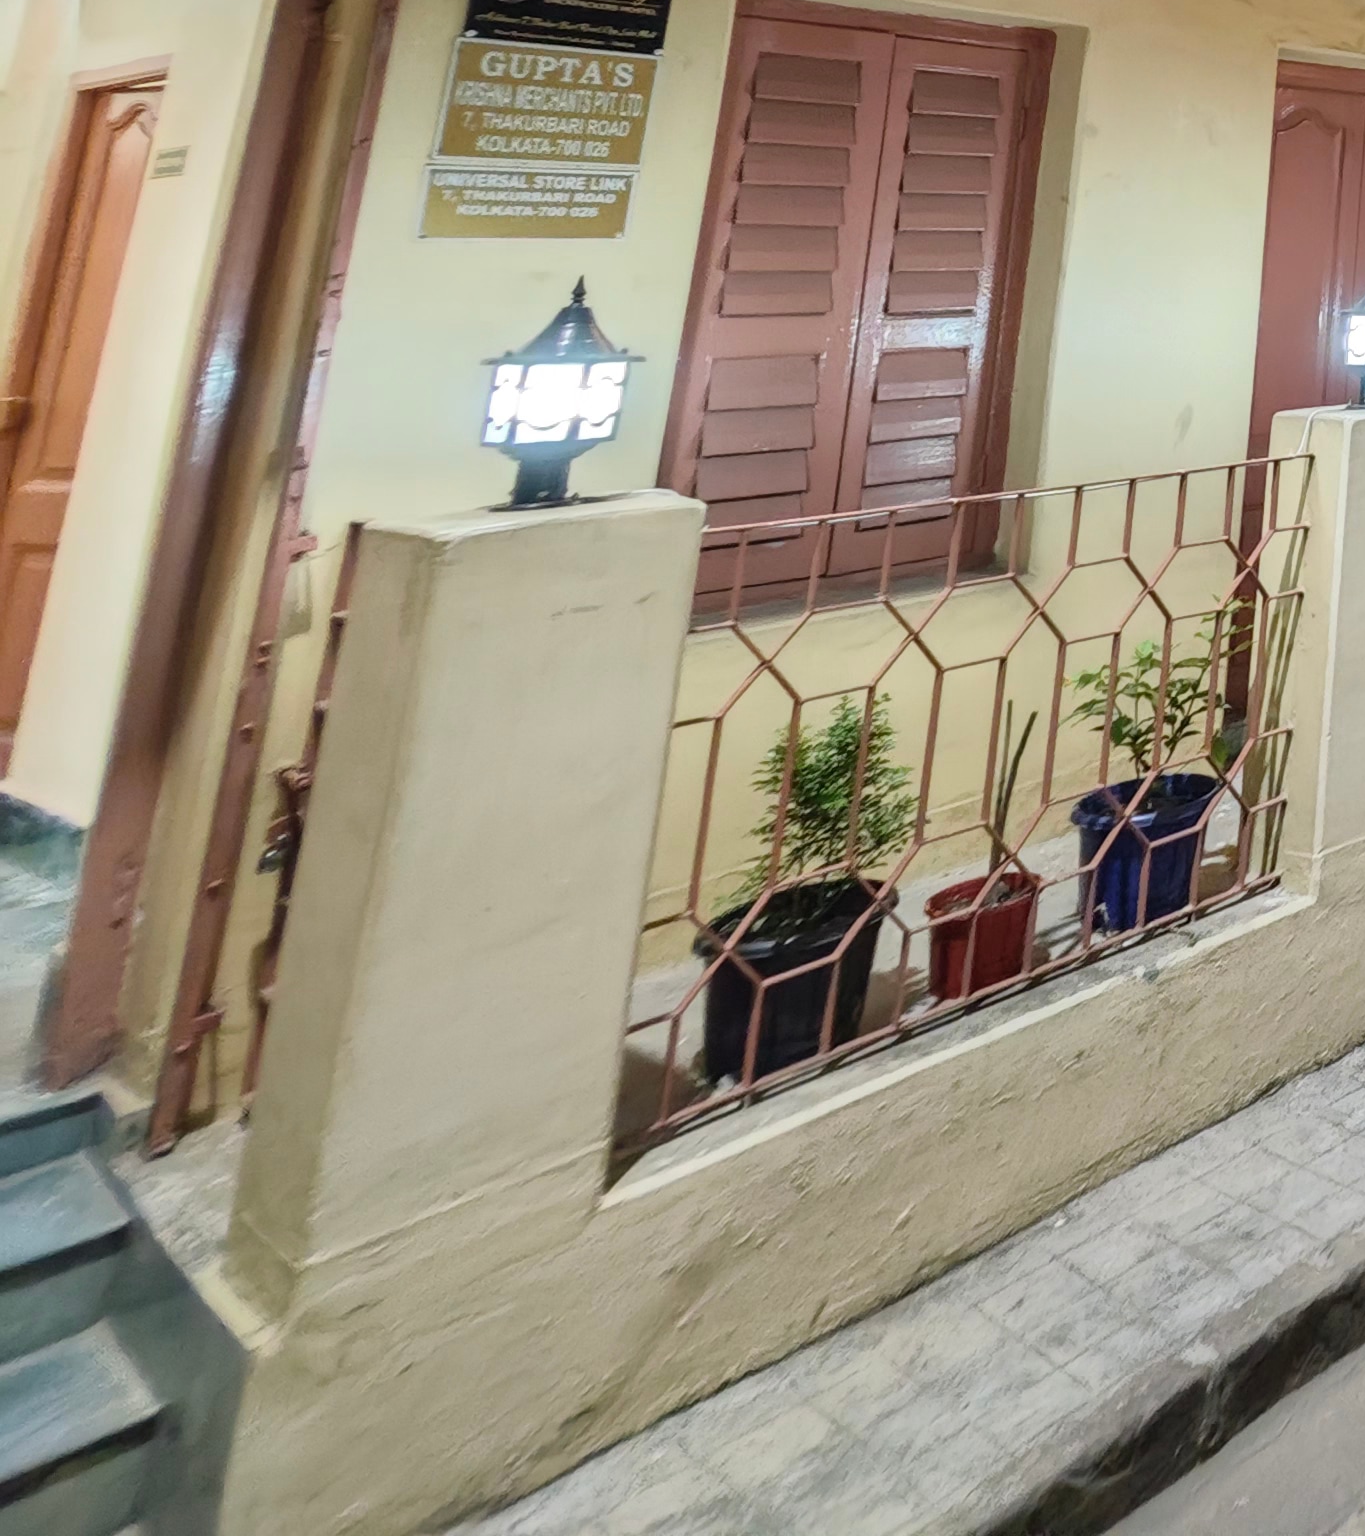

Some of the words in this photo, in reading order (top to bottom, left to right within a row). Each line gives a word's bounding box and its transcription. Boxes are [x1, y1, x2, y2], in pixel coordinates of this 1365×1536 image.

[480, 51, 635, 88] GUPTA'S
[482, 112, 584, 134] THAKURBARI
[586, 120, 631, 137] ROAD
[433, 173, 529, 189] UNIVERSAL
[532, 175, 586, 190] STORE
[589, 177, 628, 191] LINK
[572, 192, 617, 204] ROAD
